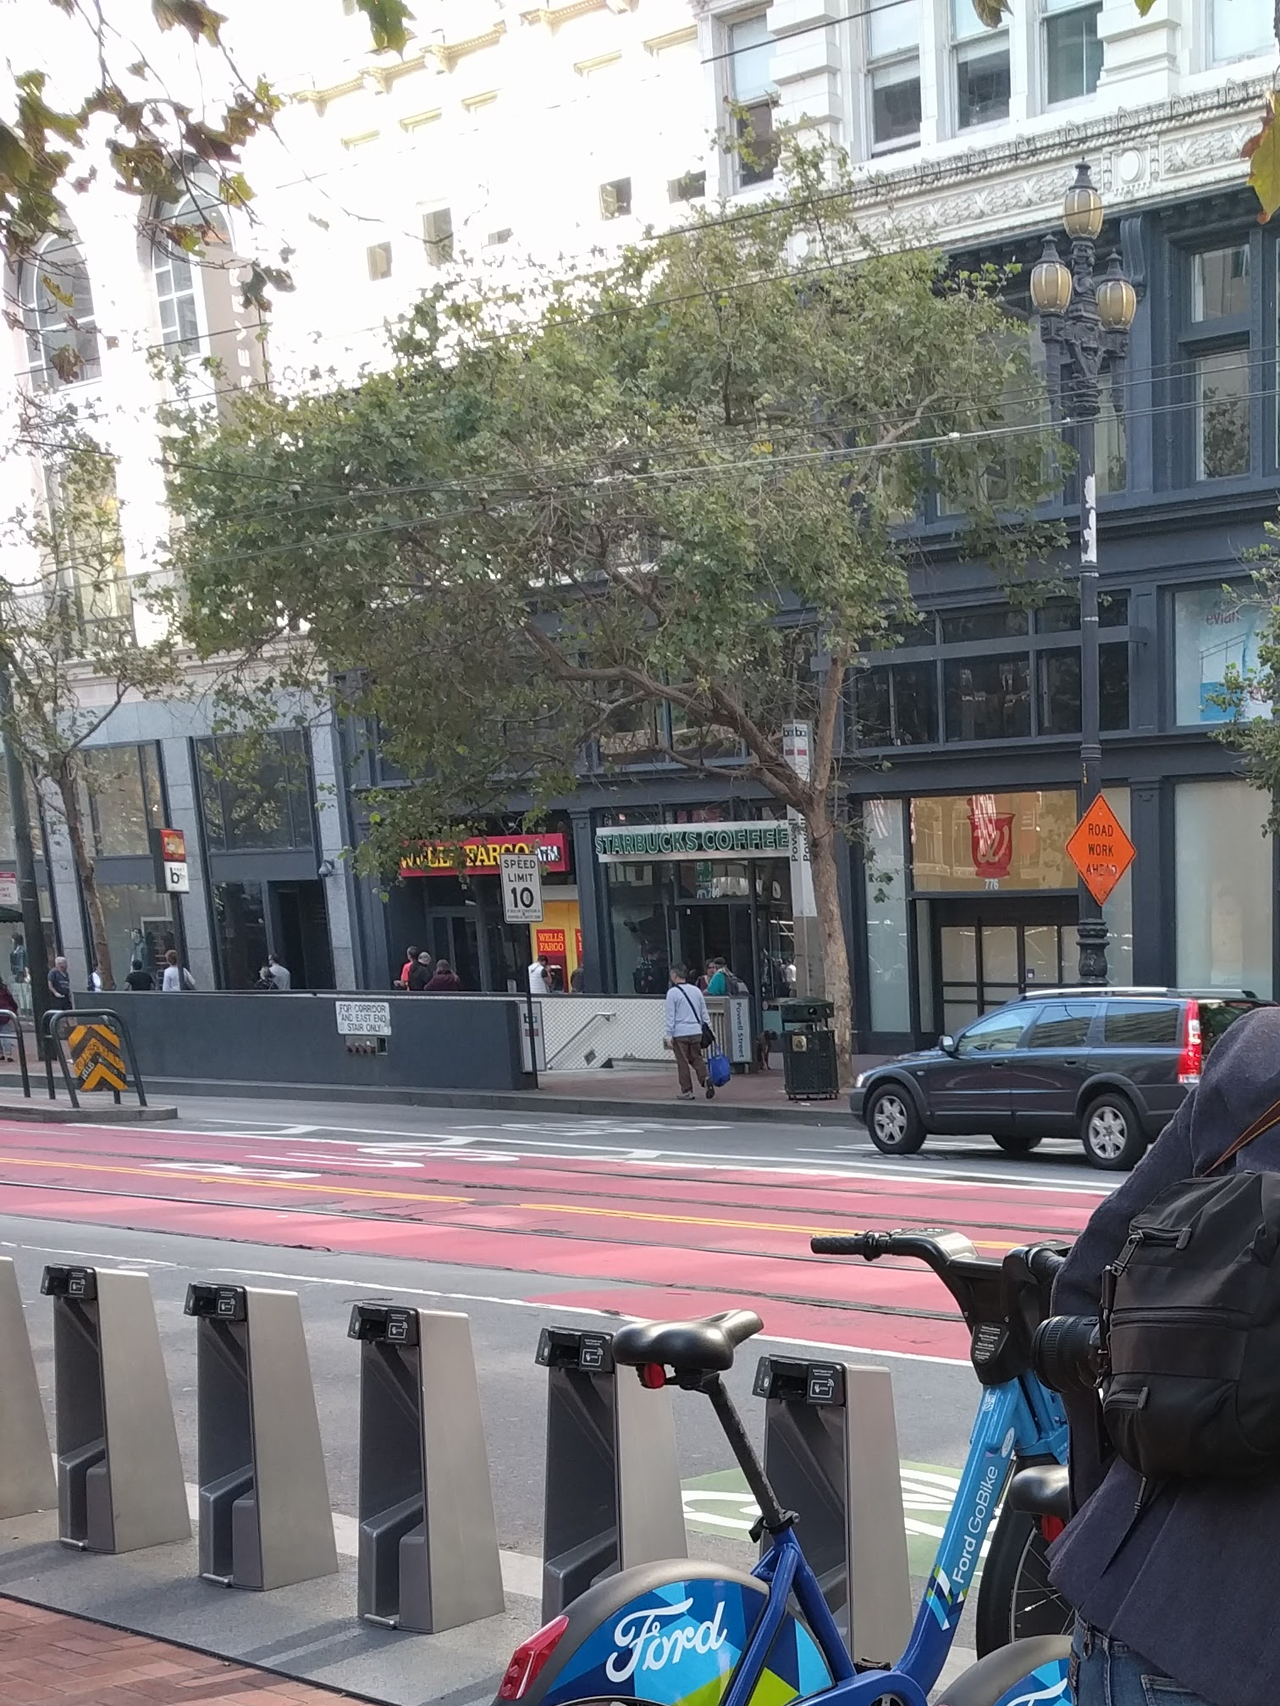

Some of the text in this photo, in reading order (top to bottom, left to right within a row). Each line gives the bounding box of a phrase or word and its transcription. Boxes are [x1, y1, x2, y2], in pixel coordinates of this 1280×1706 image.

[1088, 823, 1114, 837] ROAD
[595, 827, 789, 856] STARBUCKS COFFEE
[1088, 843, 1114, 857] WORK
[401, 845, 457, 869] WLL
[504, 859, 536, 869] SPEED
[1086, 863, 1118, 876] AHEAD
[508, 873, 533, 883] LIMIT
[984, 879, 999, 891] 776
[511, 886, 534, 909] 10
[538, 932, 564, 942] WELLS
[539, 942, 564, 951] FARGO
[339, 1003, 386, 1014] FOR CORRIDOR
[341, 1013, 387, 1023] AND EAST END
[347, 1023, 381, 1032] STAIR ONLY
[952, 1465, 999, 1584] Ford GoBike
[605, 1597, 728, 1683] Ford
